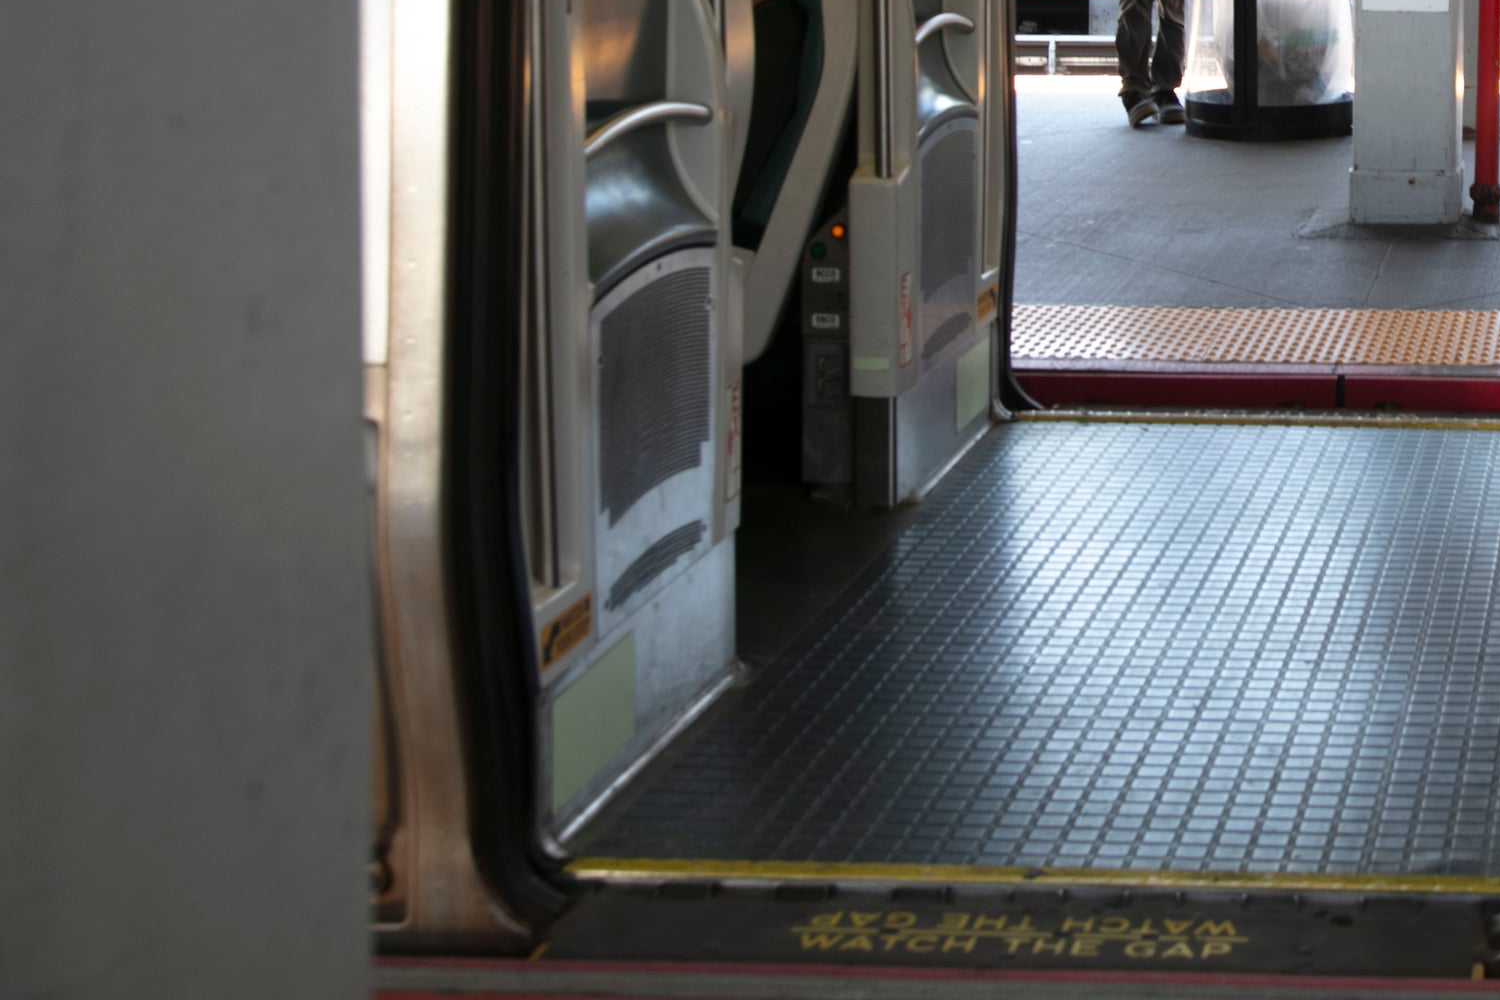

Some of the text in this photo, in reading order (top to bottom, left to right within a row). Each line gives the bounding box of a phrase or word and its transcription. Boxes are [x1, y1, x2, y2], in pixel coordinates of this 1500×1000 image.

[809, 911, 1238, 936] WATCH THE GAP
[799, 933, 1233, 961] WATCH THE GAP
